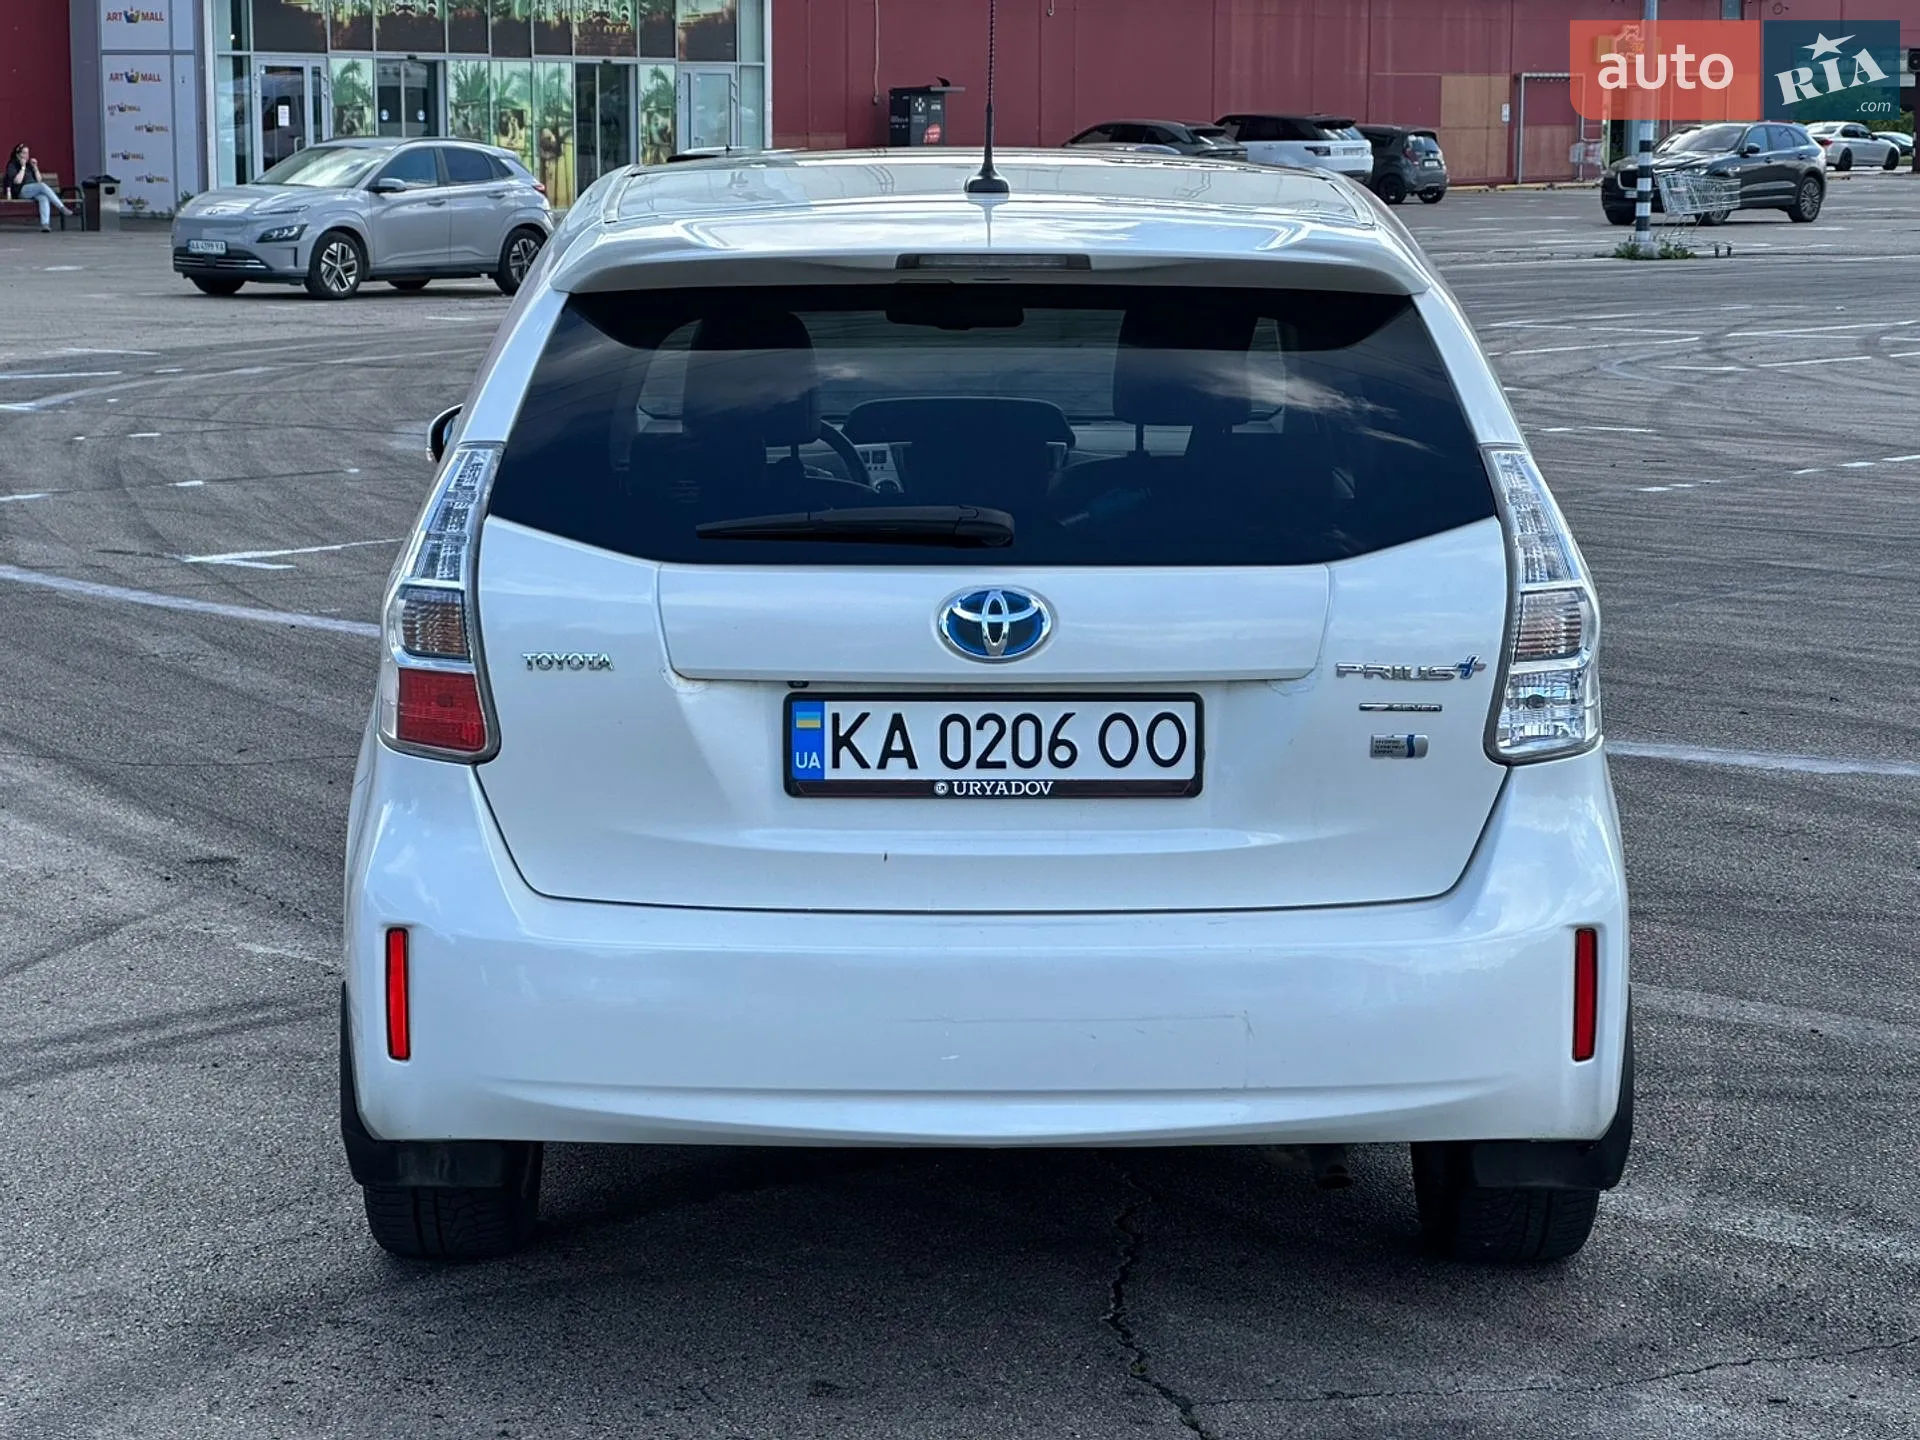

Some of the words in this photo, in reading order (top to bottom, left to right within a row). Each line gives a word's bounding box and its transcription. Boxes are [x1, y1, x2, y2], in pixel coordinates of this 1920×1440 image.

[106, 11, 123, 21] ART
[141, 11, 164, 21] MALL
[109, 72, 123, 81] ART
[140, 72, 162, 82] MALL
[522, 652, 614, 672] TOYOTA
[831, 711, 919, 770] KA
[939, 712, 1078, 770] 0206
[1097, 711, 1188, 769] OO
[795, 752, 821, 769] UA
[953, 781, 1054, 796] URYADOV
